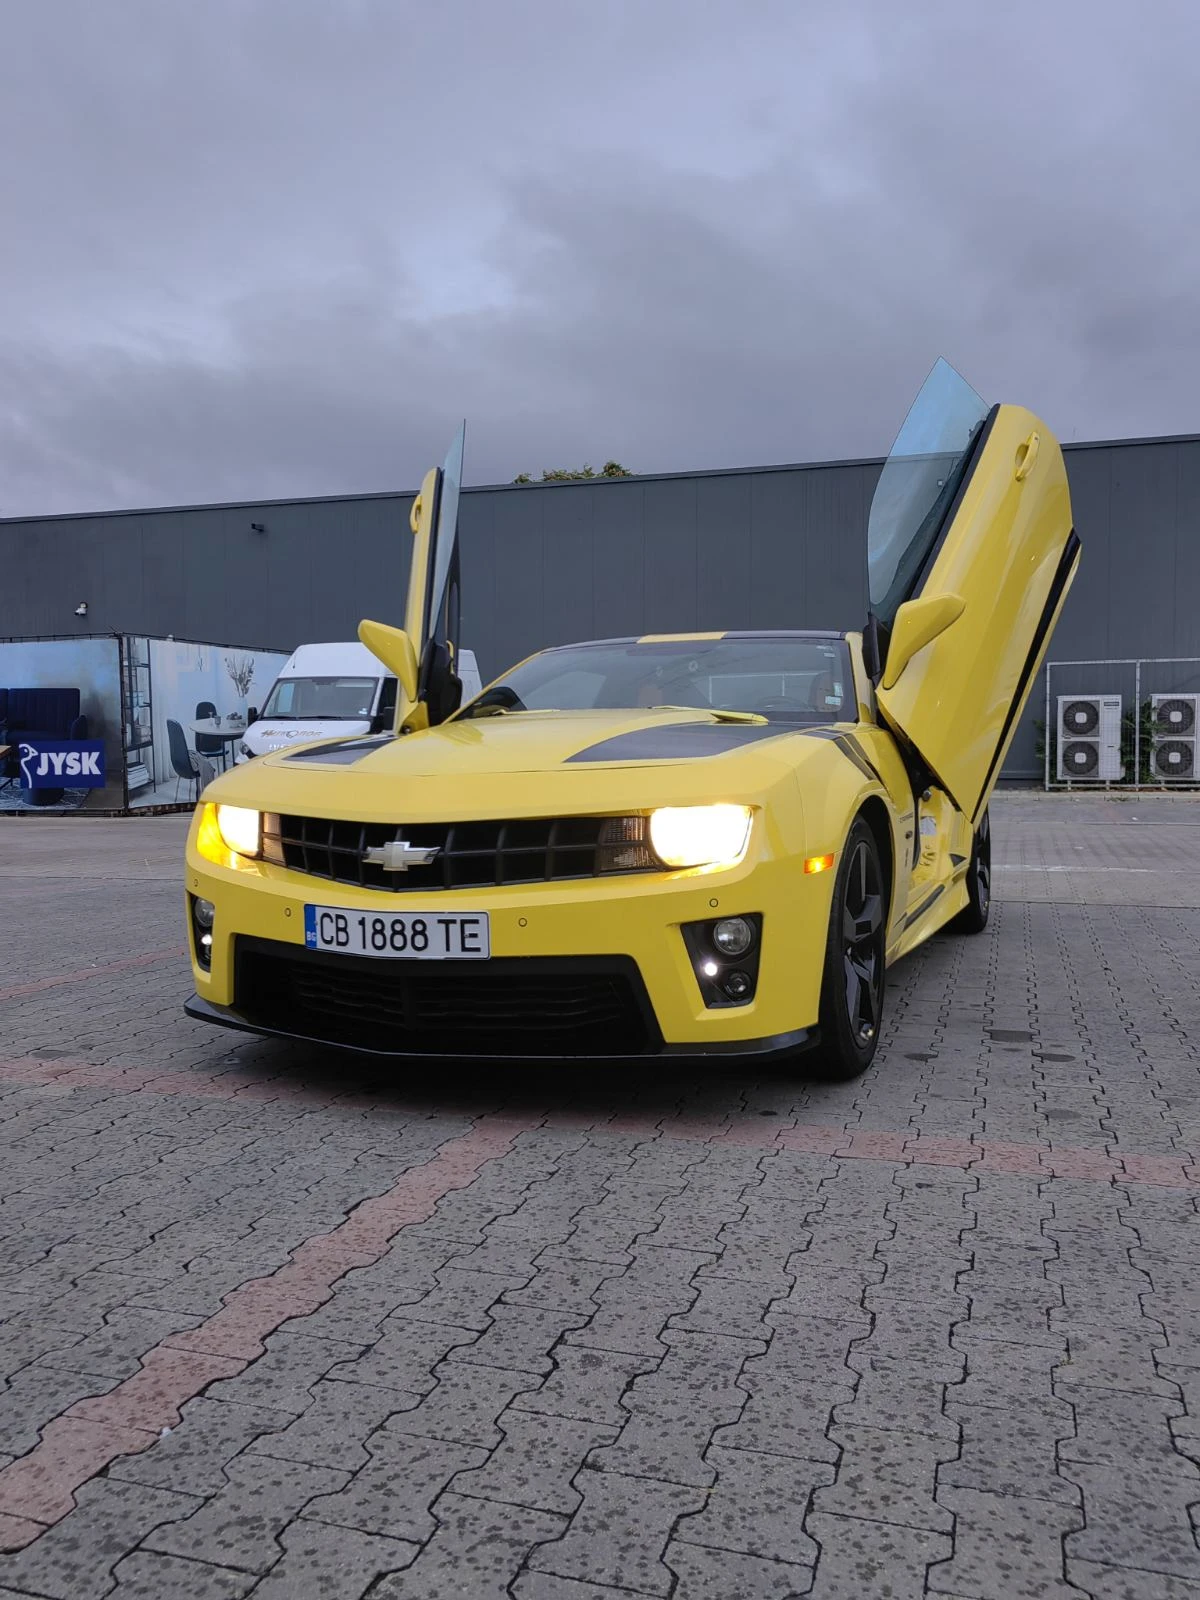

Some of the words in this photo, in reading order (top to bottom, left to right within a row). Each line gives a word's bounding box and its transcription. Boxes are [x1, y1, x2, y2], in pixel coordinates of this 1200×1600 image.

[36, 752, 101, 776] JYSK
[306, 931, 317, 941] BG
[320, 912, 349, 947] CB
[358, 917, 428, 951] 1888
[437, 919, 482, 952] TE
